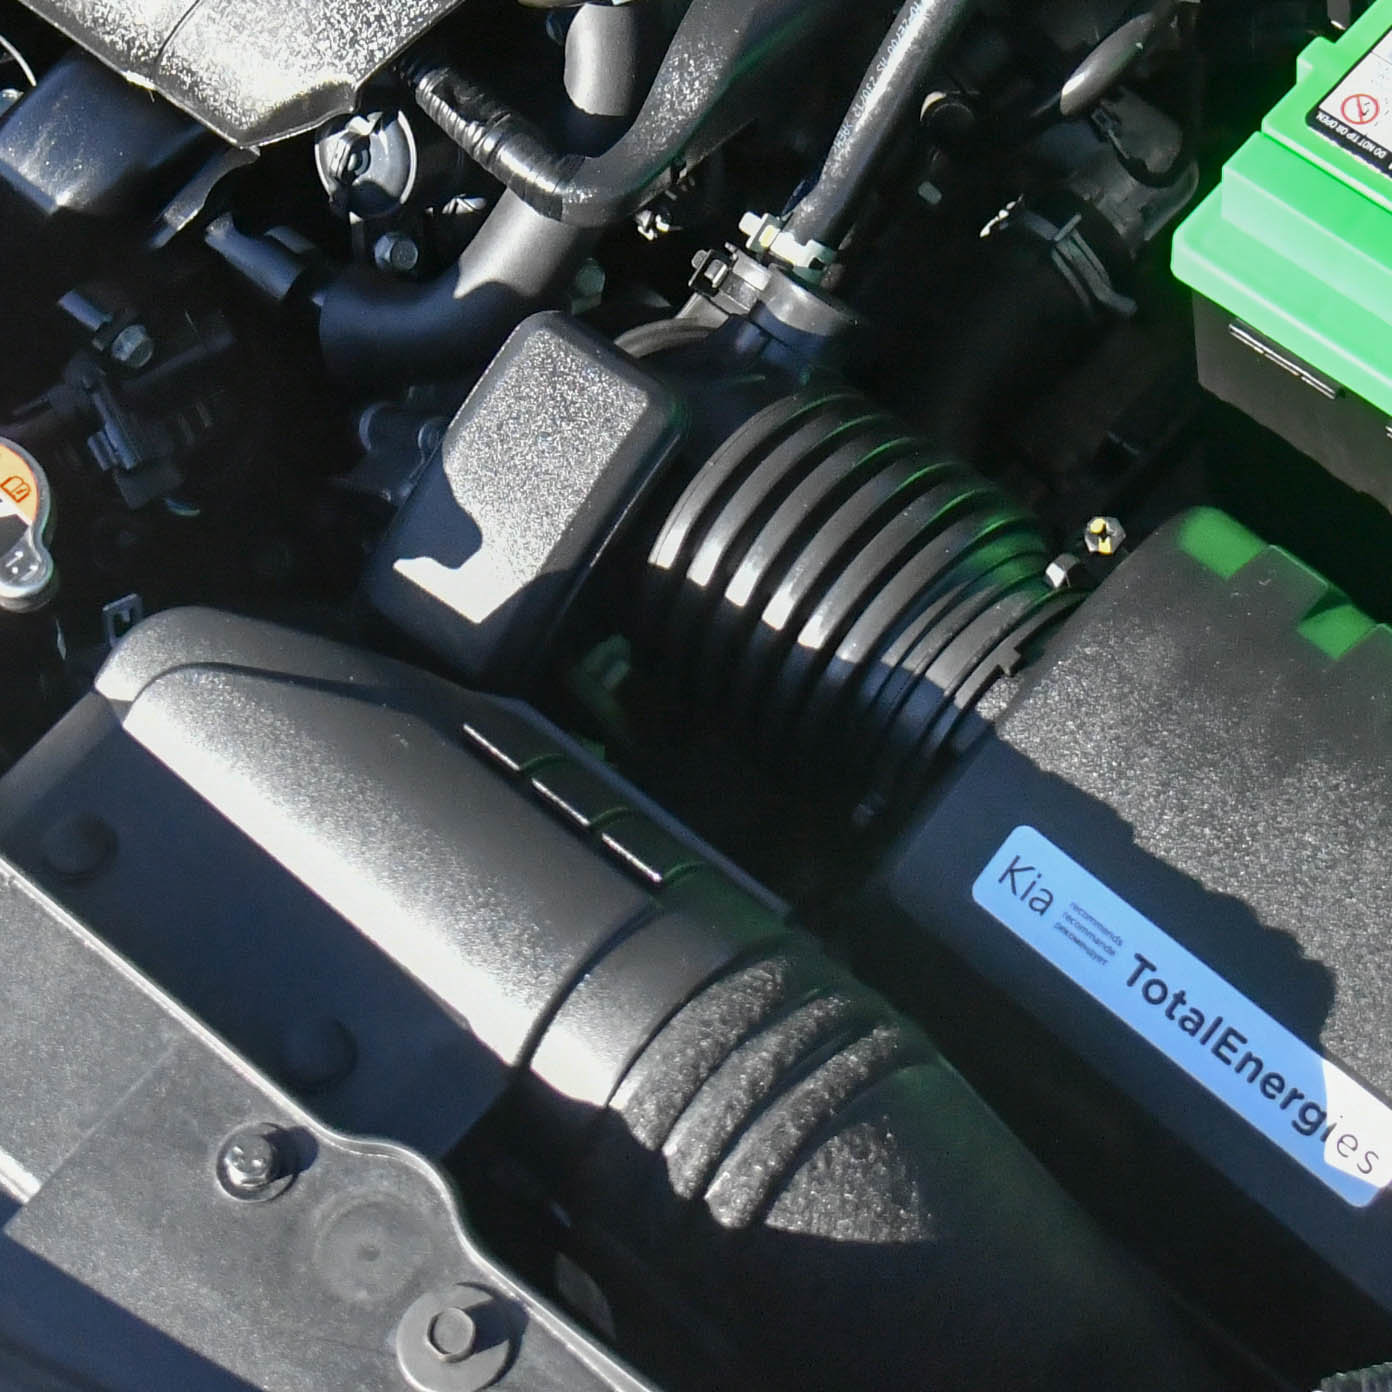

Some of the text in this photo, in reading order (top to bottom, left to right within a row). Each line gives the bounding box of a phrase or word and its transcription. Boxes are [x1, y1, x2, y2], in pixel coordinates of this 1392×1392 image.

[1359, 138, 1377, 153] NOT
[1374, 148, 1386, 157] DO
[997, 855, 1055, 917] Kia
[1123, 952, 1380, 1176] TotalEnergies
